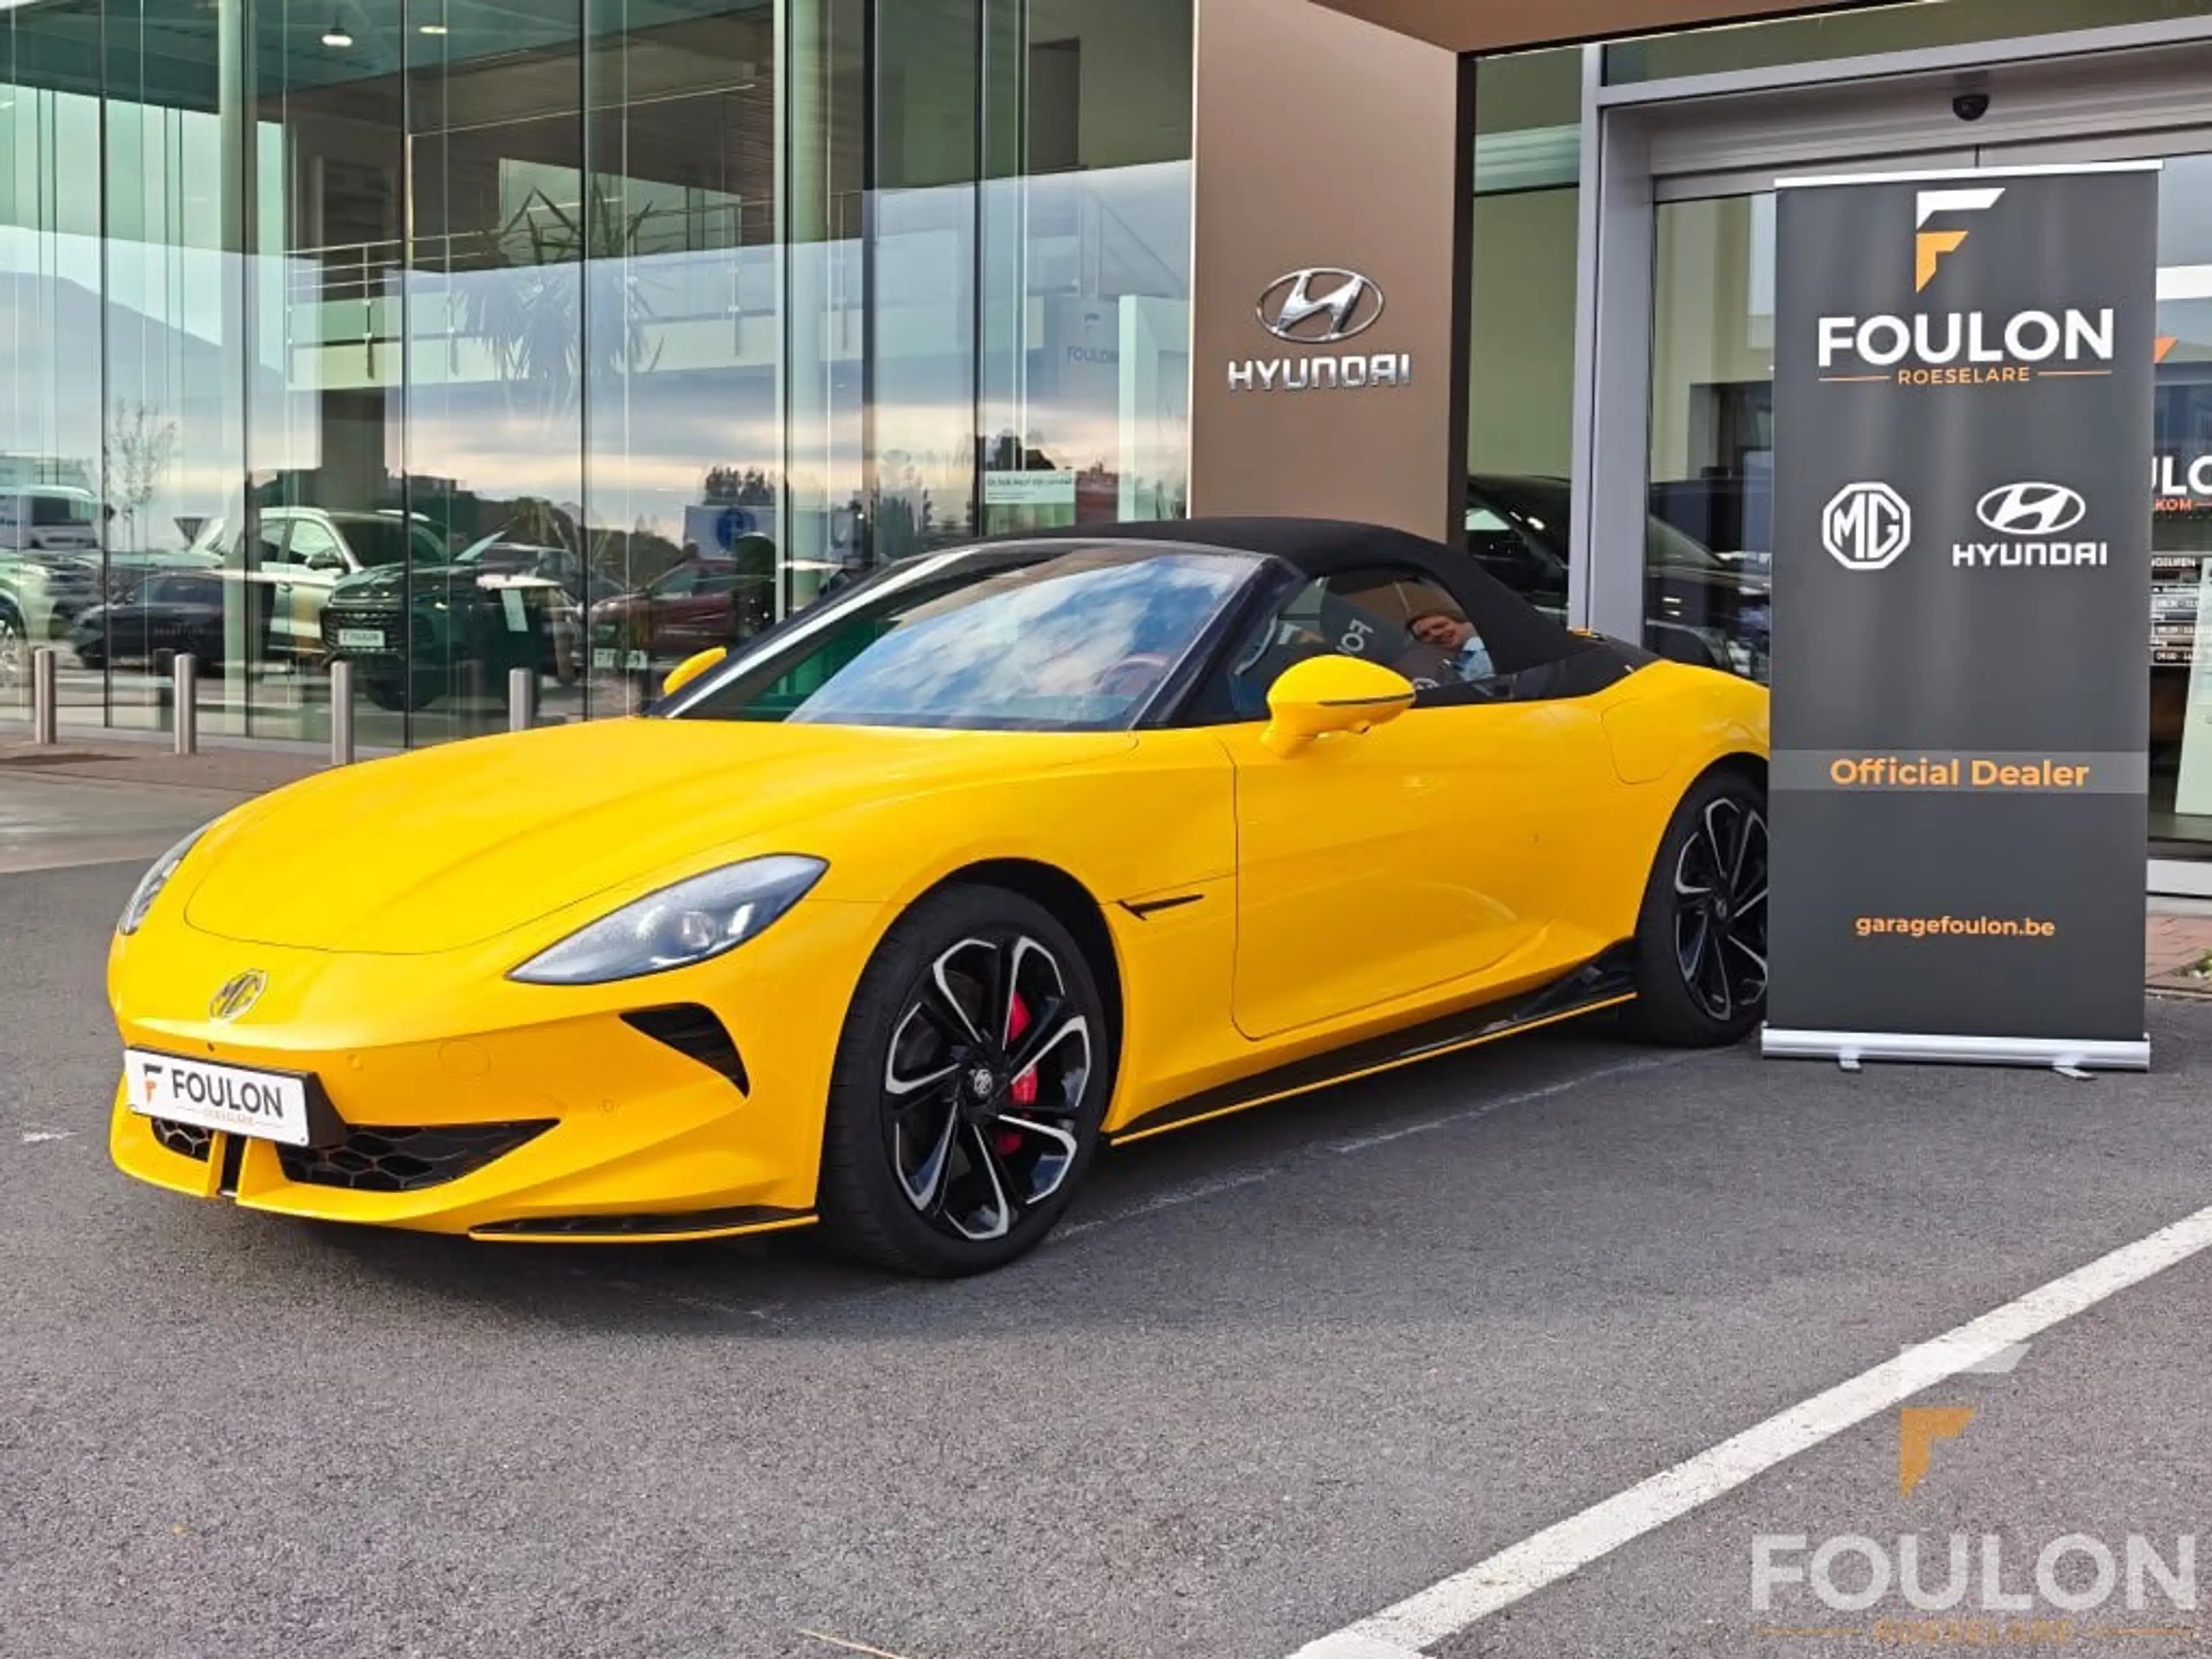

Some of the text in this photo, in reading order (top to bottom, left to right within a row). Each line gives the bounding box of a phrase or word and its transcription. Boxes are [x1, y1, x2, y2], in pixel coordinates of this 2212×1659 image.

[1818, 309, 2114, 367] FOULON
[1228, 354, 1411, 391] HYUNDAI
[1897, 367, 2031, 385] ROESELARE
[1831, 490, 1903, 560] MG
[1952, 541, 2107, 567] HYUNDAI
[1830, 757, 2090, 787] Official Dealer
[1855, 915, 2055, 938] garagefoulon.be
[172, 1068, 283, 1118] FOULON
